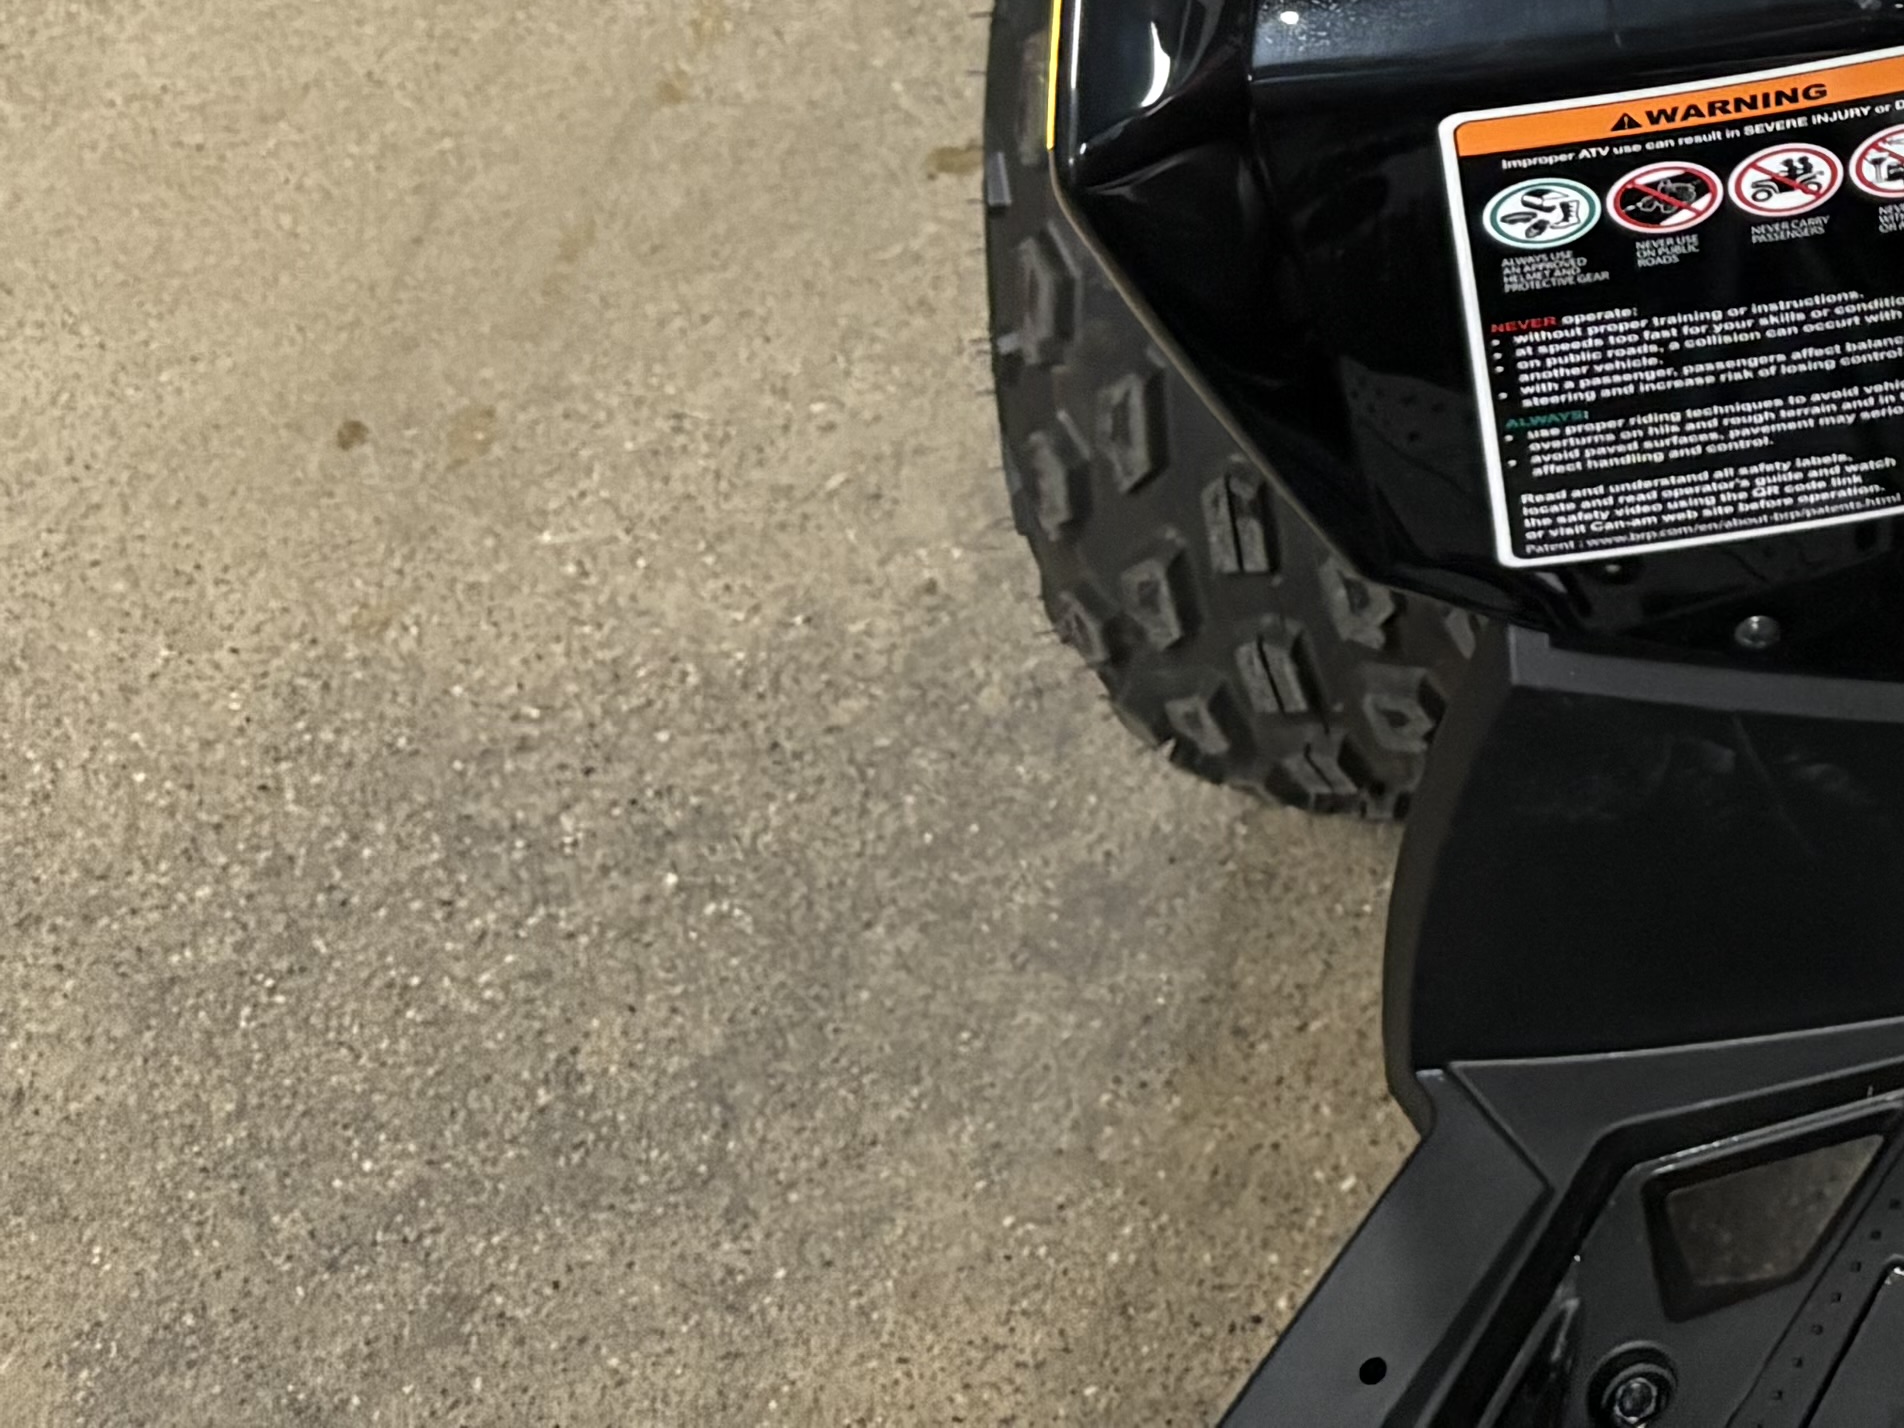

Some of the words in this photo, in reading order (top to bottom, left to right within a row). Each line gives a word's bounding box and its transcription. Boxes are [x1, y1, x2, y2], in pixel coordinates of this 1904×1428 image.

[1646, 83, 1827, 125] WARNING
[1501, 152, 1575, 170] Improper
[1577, 145, 1611, 160] ATV
[1612, 143, 1643, 156] use
[1644, 138, 1676, 151] can
[1677, 130, 1723, 146] result
[1743, 116, 1809, 137] SEVERE
[1811, 105, 1872, 125] INJURY
